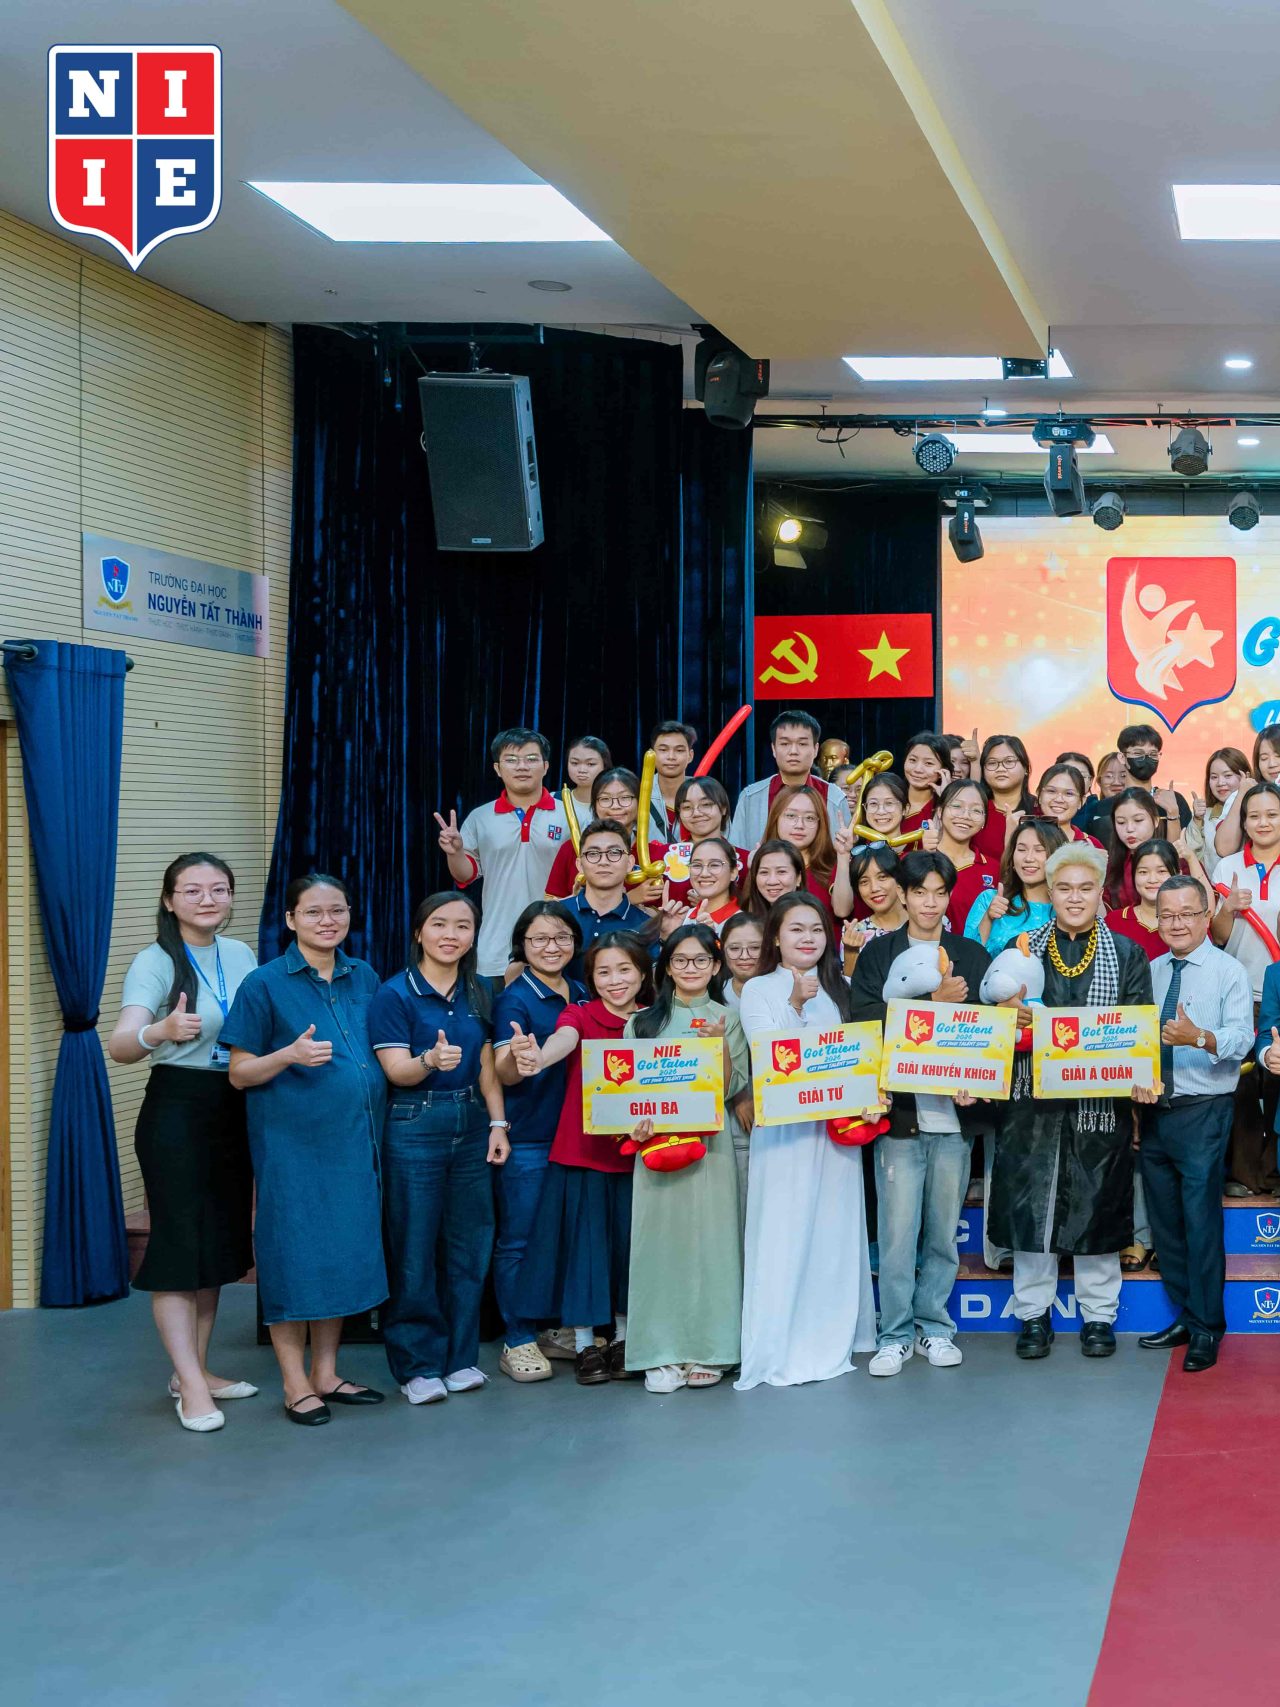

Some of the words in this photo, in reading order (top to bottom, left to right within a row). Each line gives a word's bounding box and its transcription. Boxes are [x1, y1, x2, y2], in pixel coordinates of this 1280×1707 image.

[148, 570, 188, 592] TRƯỜNG
[190, 580, 206, 595] ĐẠI
[208, 583, 228, 600] HỌC
[148, 592, 197, 618] NGUYỄN
[200, 600, 222, 622] TẤT
[225, 604, 263, 631] THÀNH
[952, 1010, 980, 1023] NIIE
[1096, 1012, 1123, 1026] NIIE
[936, 1022, 956, 1033] Got
[958, 1023, 993, 1035] Talent
[1082, 1026, 1101, 1037] Got
[1102, 1024, 1137, 1036] Talent
[818, 1030, 845, 1046] NIIE
[653, 1045, 682, 1058] NIIE
[803, 1046, 823, 1059] Got
[825, 1042, 860, 1056] Talent
[637, 1060, 658, 1071] Got
[660, 1057, 698, 1070] Talent
[897, 1060, 919, 1075] GIẢI
[921, 1062, 962, 1078] KHUYẾN
[964, 1066, 996, 1081] KHÍCH
[1061, 1064, 1086, 1081] GIẢI
[1101, 1064, 1133, 1082] QUÂN
[798, 1086, 824, 1105] GIẢI
[827, 1084, 844, 1101] TƯ
[630, 1099, 657, 1116] GIẢI
[661, 1101, 679, 1115] BA
